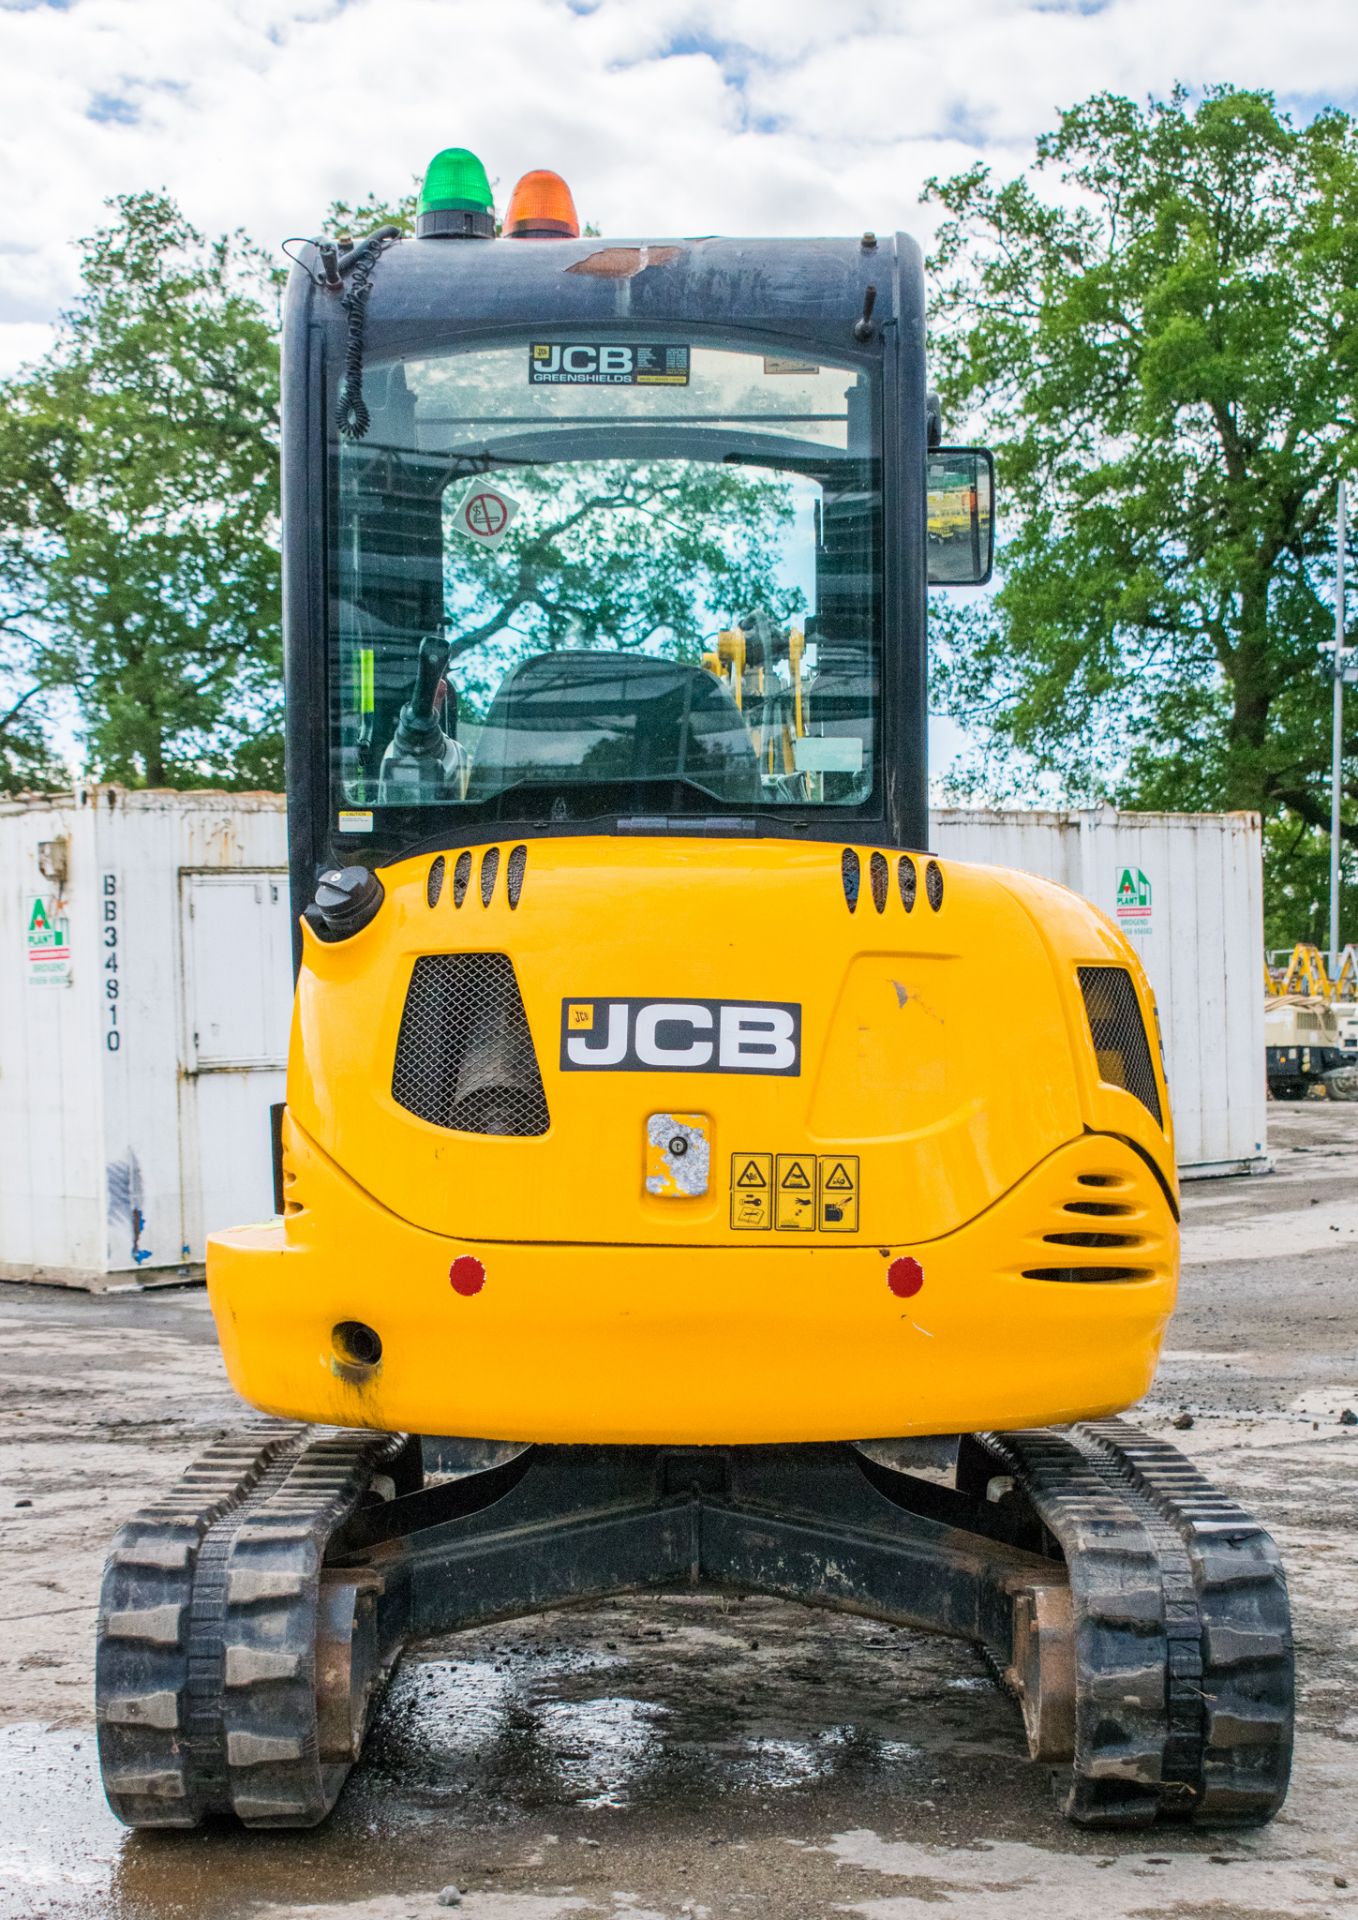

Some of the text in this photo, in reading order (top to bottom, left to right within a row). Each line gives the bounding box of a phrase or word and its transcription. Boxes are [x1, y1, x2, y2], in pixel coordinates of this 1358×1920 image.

[533, 345, 633, 374] JCB
[534, 374, 632, 383] GREENSHIELDS
[1118, 869, 1136, 894] A
[1116, 896, 1138, 905] PLANT
[29, 898, 51, 931] A
[28, 934, 52, 945] PLANT
[567, 1003, 796, 1069] JCB
